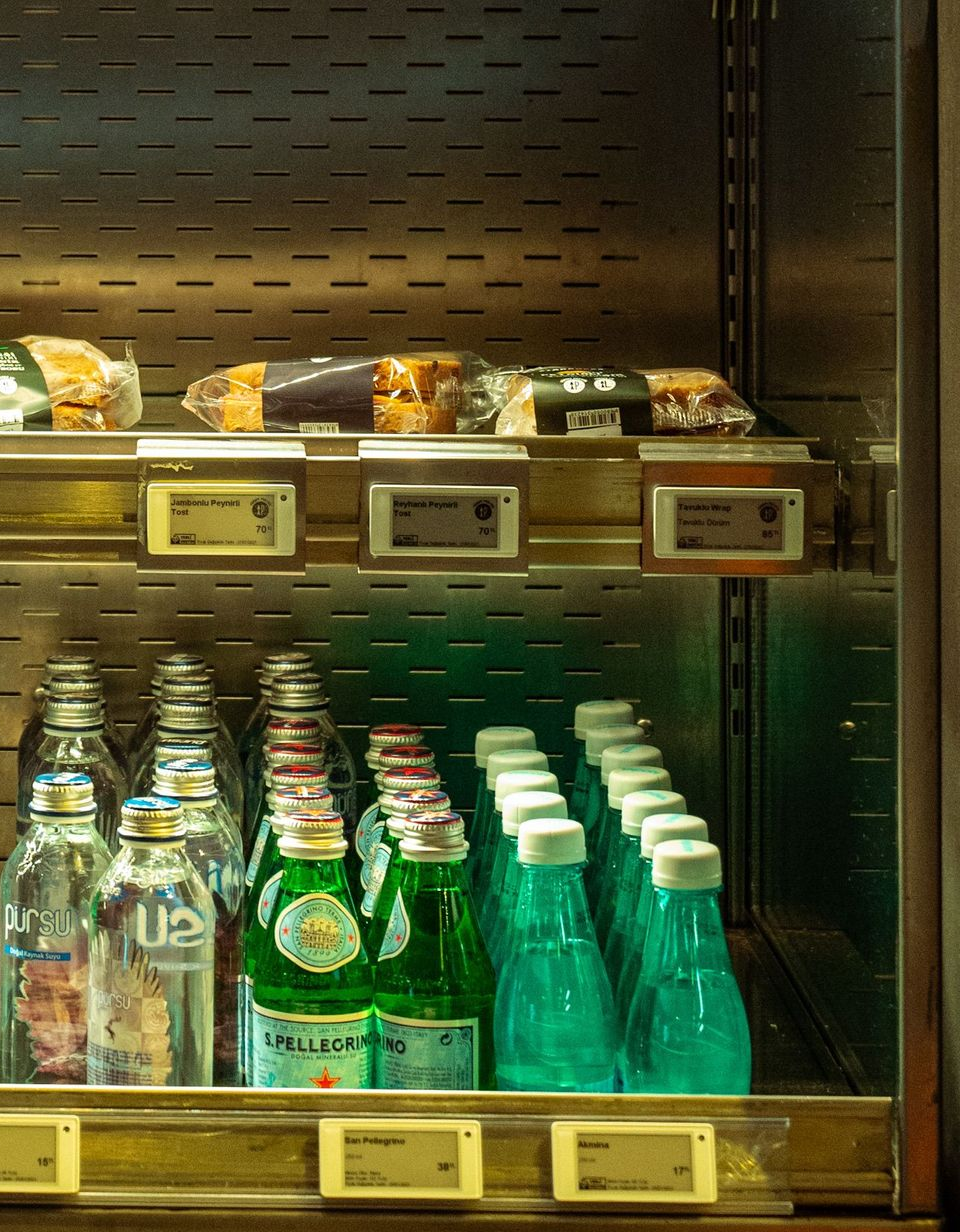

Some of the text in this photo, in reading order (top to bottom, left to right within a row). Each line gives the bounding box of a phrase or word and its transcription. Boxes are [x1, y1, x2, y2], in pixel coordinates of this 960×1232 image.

[210, 500, 240, 508] Peynirli
[428, 501, 458, 509] Peynirli
[711, 504, 732, 512] Wrap
[256, 525, 266, 533] 70
[5, 903, 72, 940] pürsu
[9, 947, 61, 960] Doğal Kaynak Suyu
[265, 1031, 372, 1054] S.PELLEGRINO
[363, 1137, 405, 1146] Pellegrino
[37, 1157, 47, 1166] 15
[674, 1166, 683, 1175] 17
